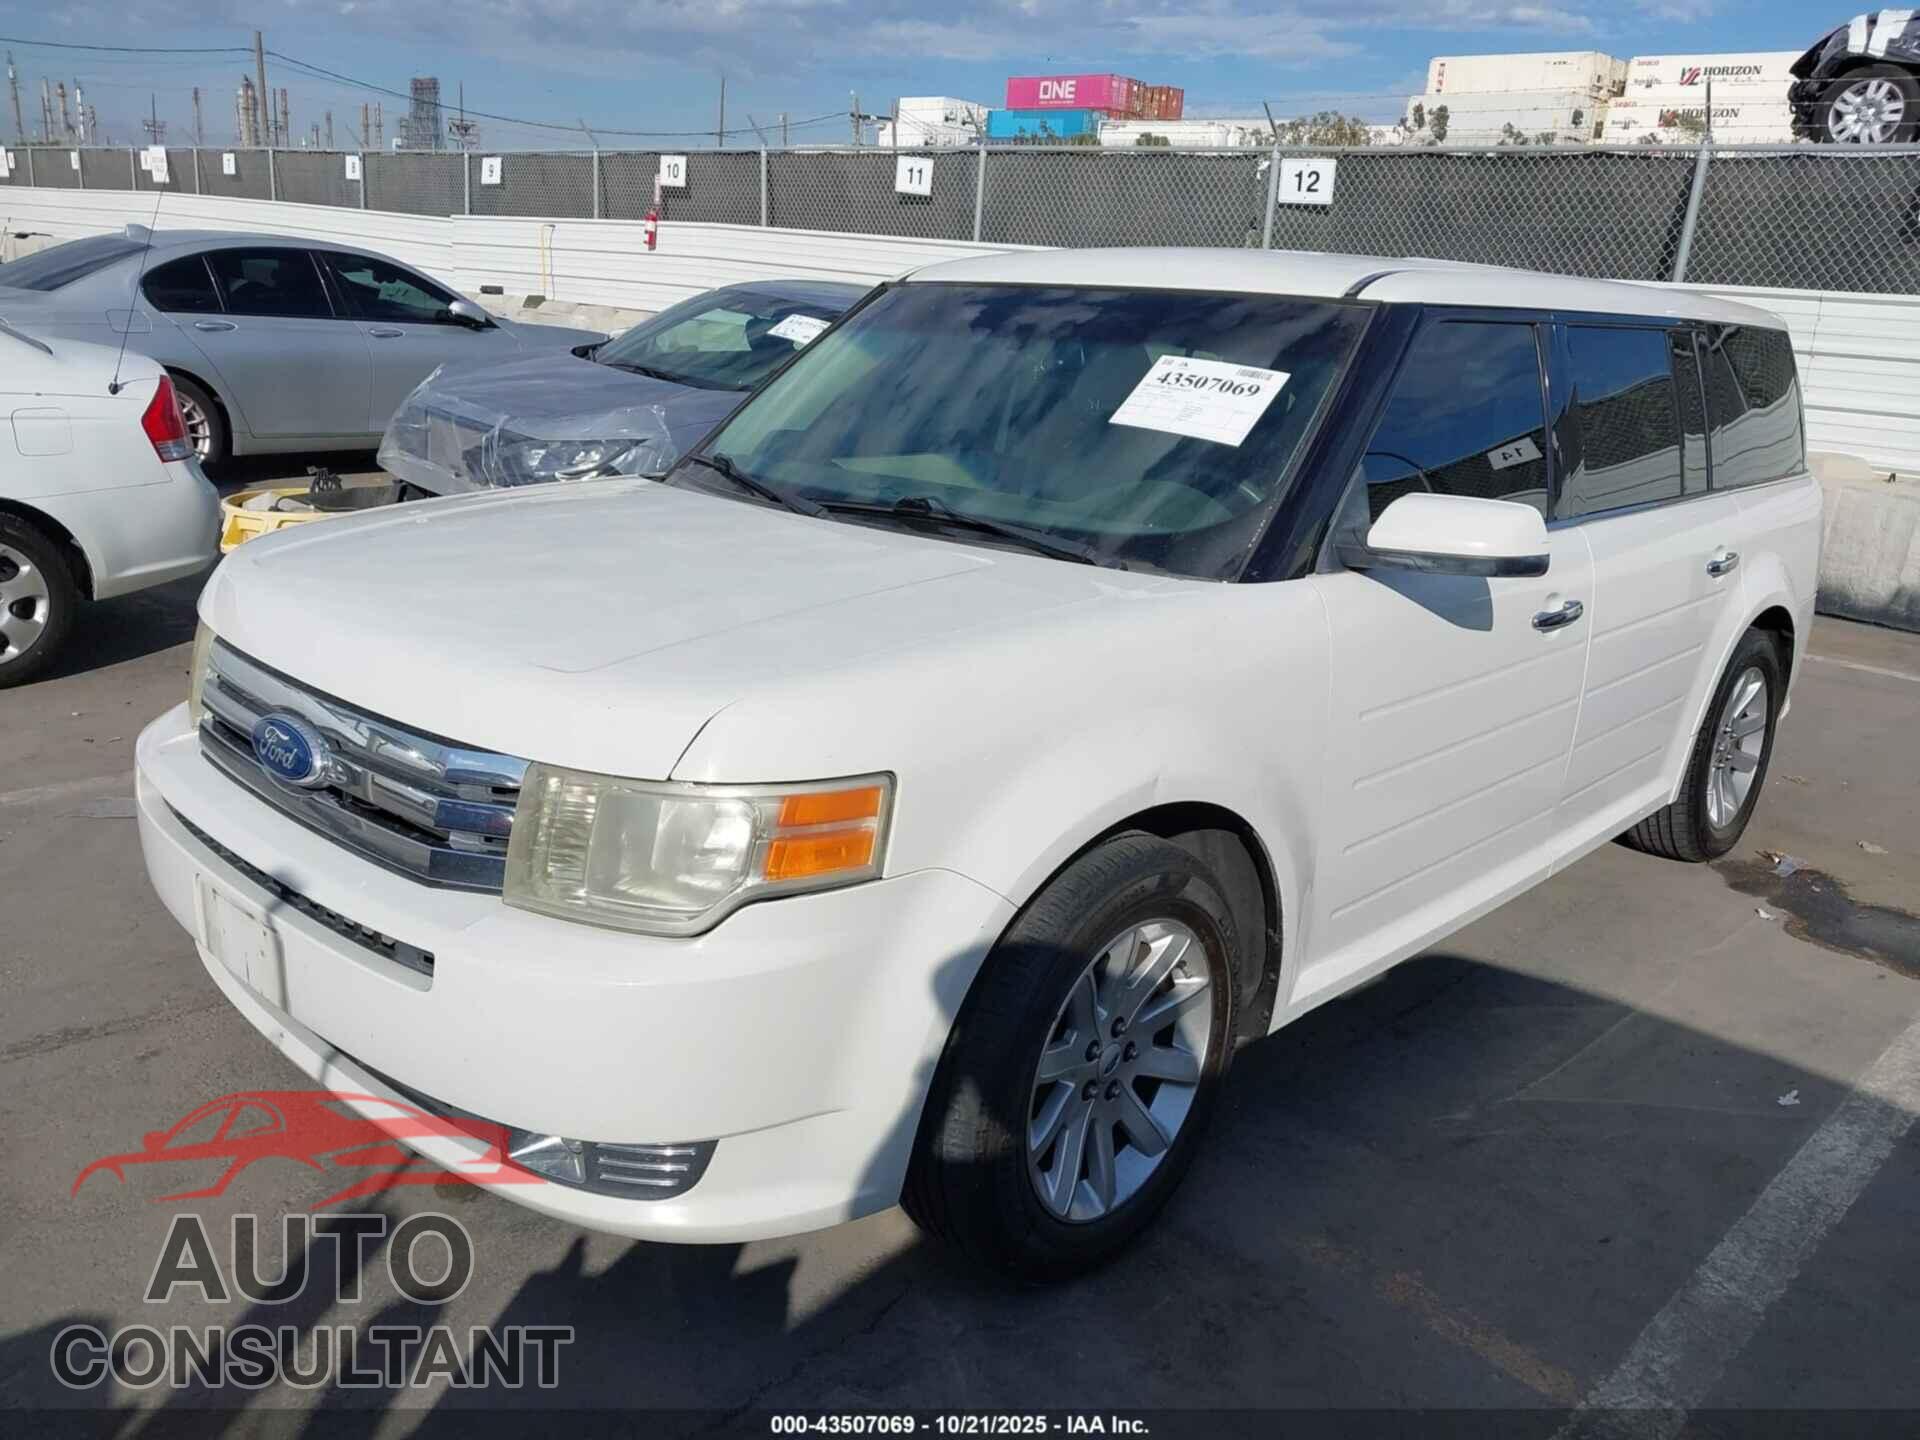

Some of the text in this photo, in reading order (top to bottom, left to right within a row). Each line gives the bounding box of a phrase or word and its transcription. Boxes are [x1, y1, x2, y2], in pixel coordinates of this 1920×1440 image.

[1703, 65, 1763, 76] HORIZON
[1039, 80, 1076, 99] ONE
[1681, 108, 1740, 118] HORZON
[667, 163, 680, 179] 10
[907, 167, 923, 185] 11
[1294, 170, 1320, 192] 12
[1157, 370, 1261, 398] 43507069
[260, 726, 298, 770] Ford
